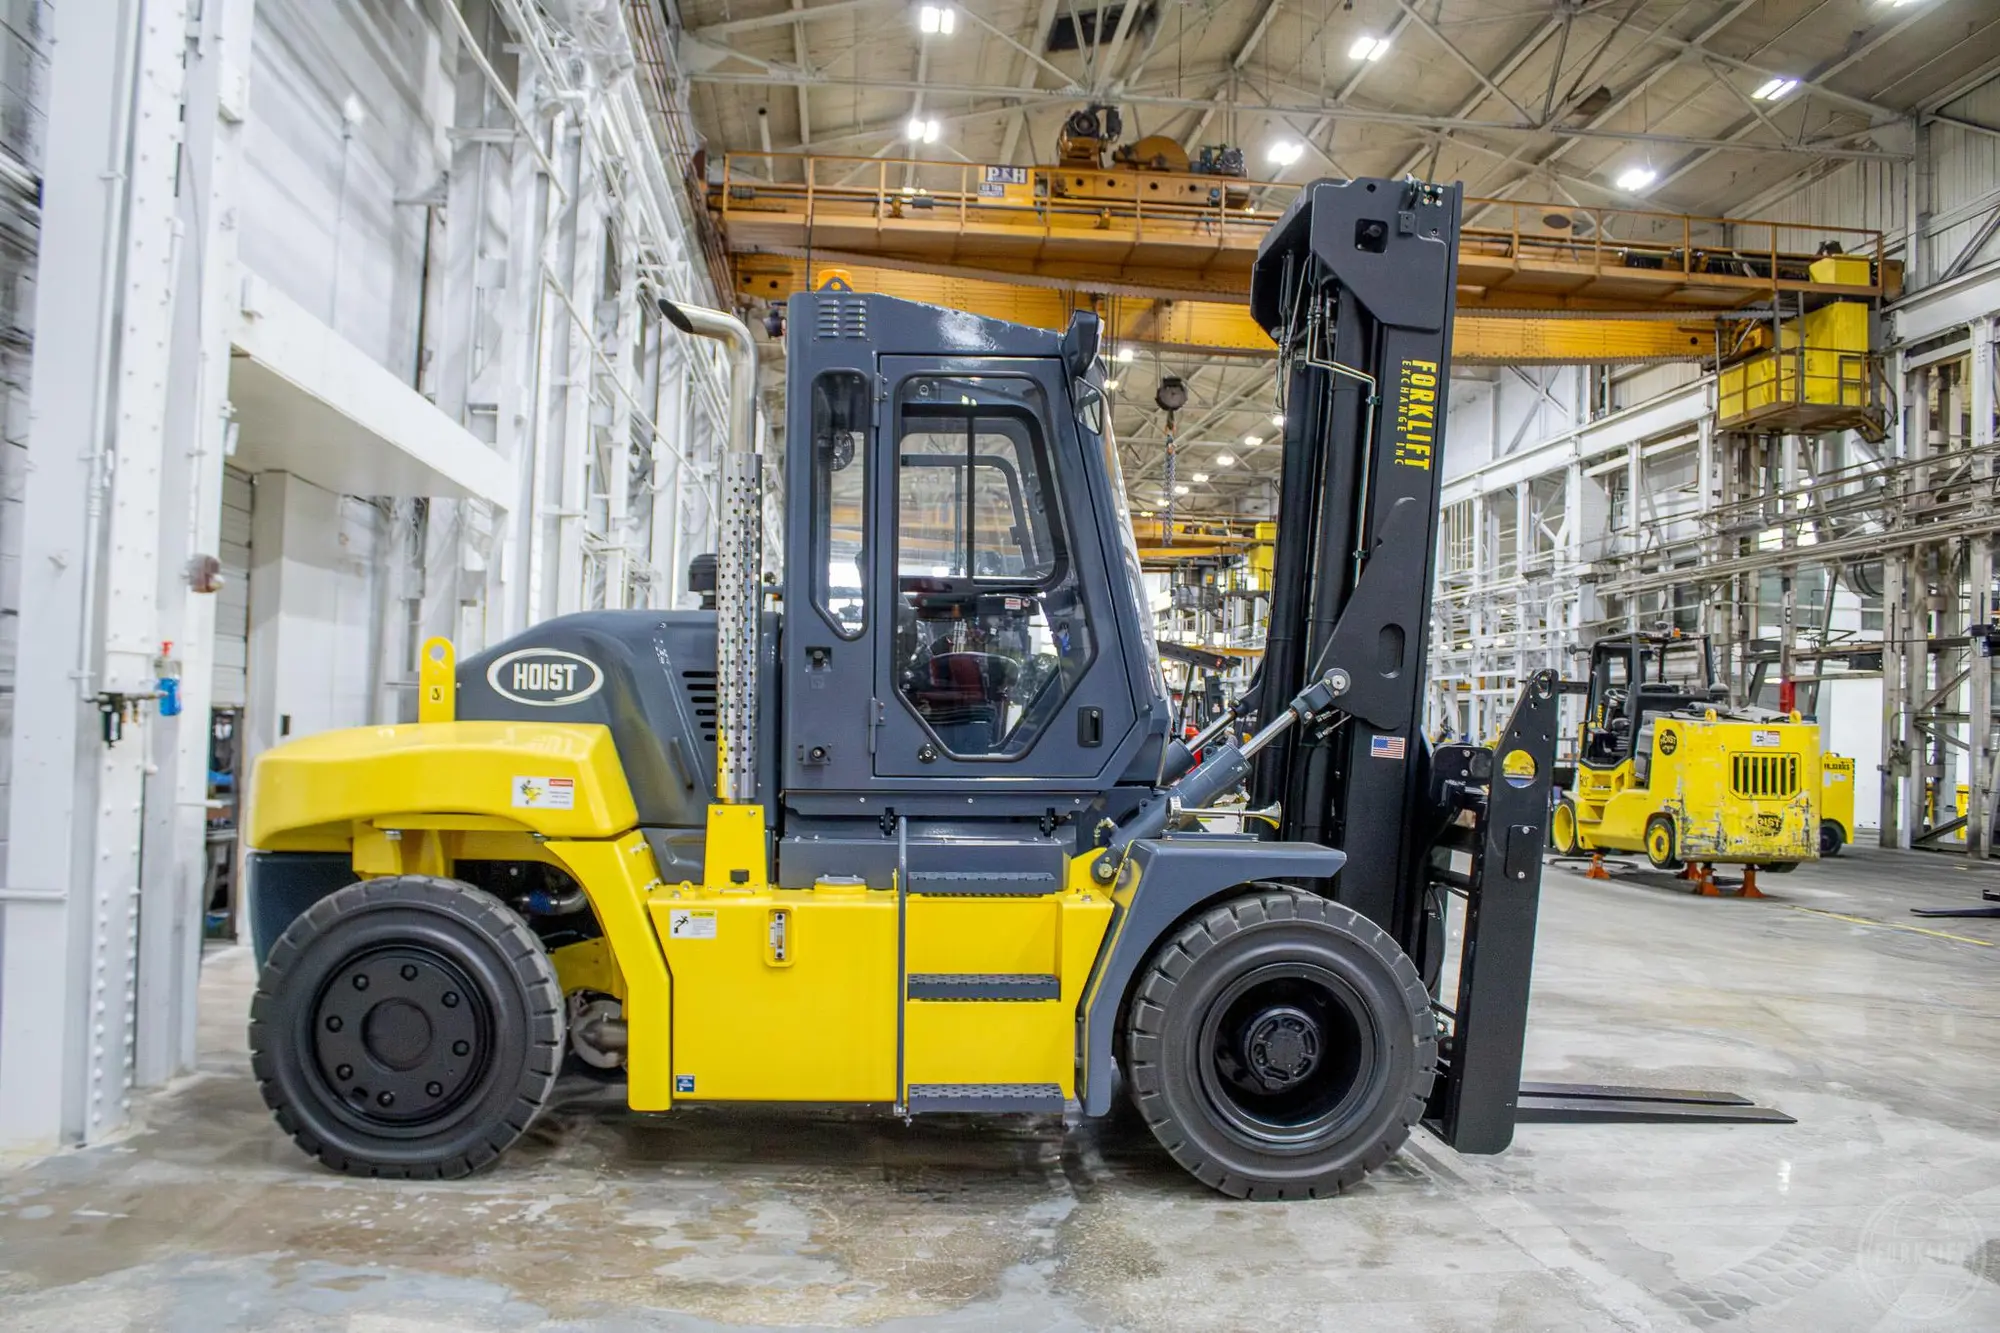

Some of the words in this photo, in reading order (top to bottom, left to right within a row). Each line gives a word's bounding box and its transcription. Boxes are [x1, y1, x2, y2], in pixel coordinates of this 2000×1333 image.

[1397, 360, 1411, 432] EXCHANGE
[1404, 360, 1437, 470] FORKLIFT
[1395, 442, 1405, 466] INC
[512, 662, 578, 692] HOIST
